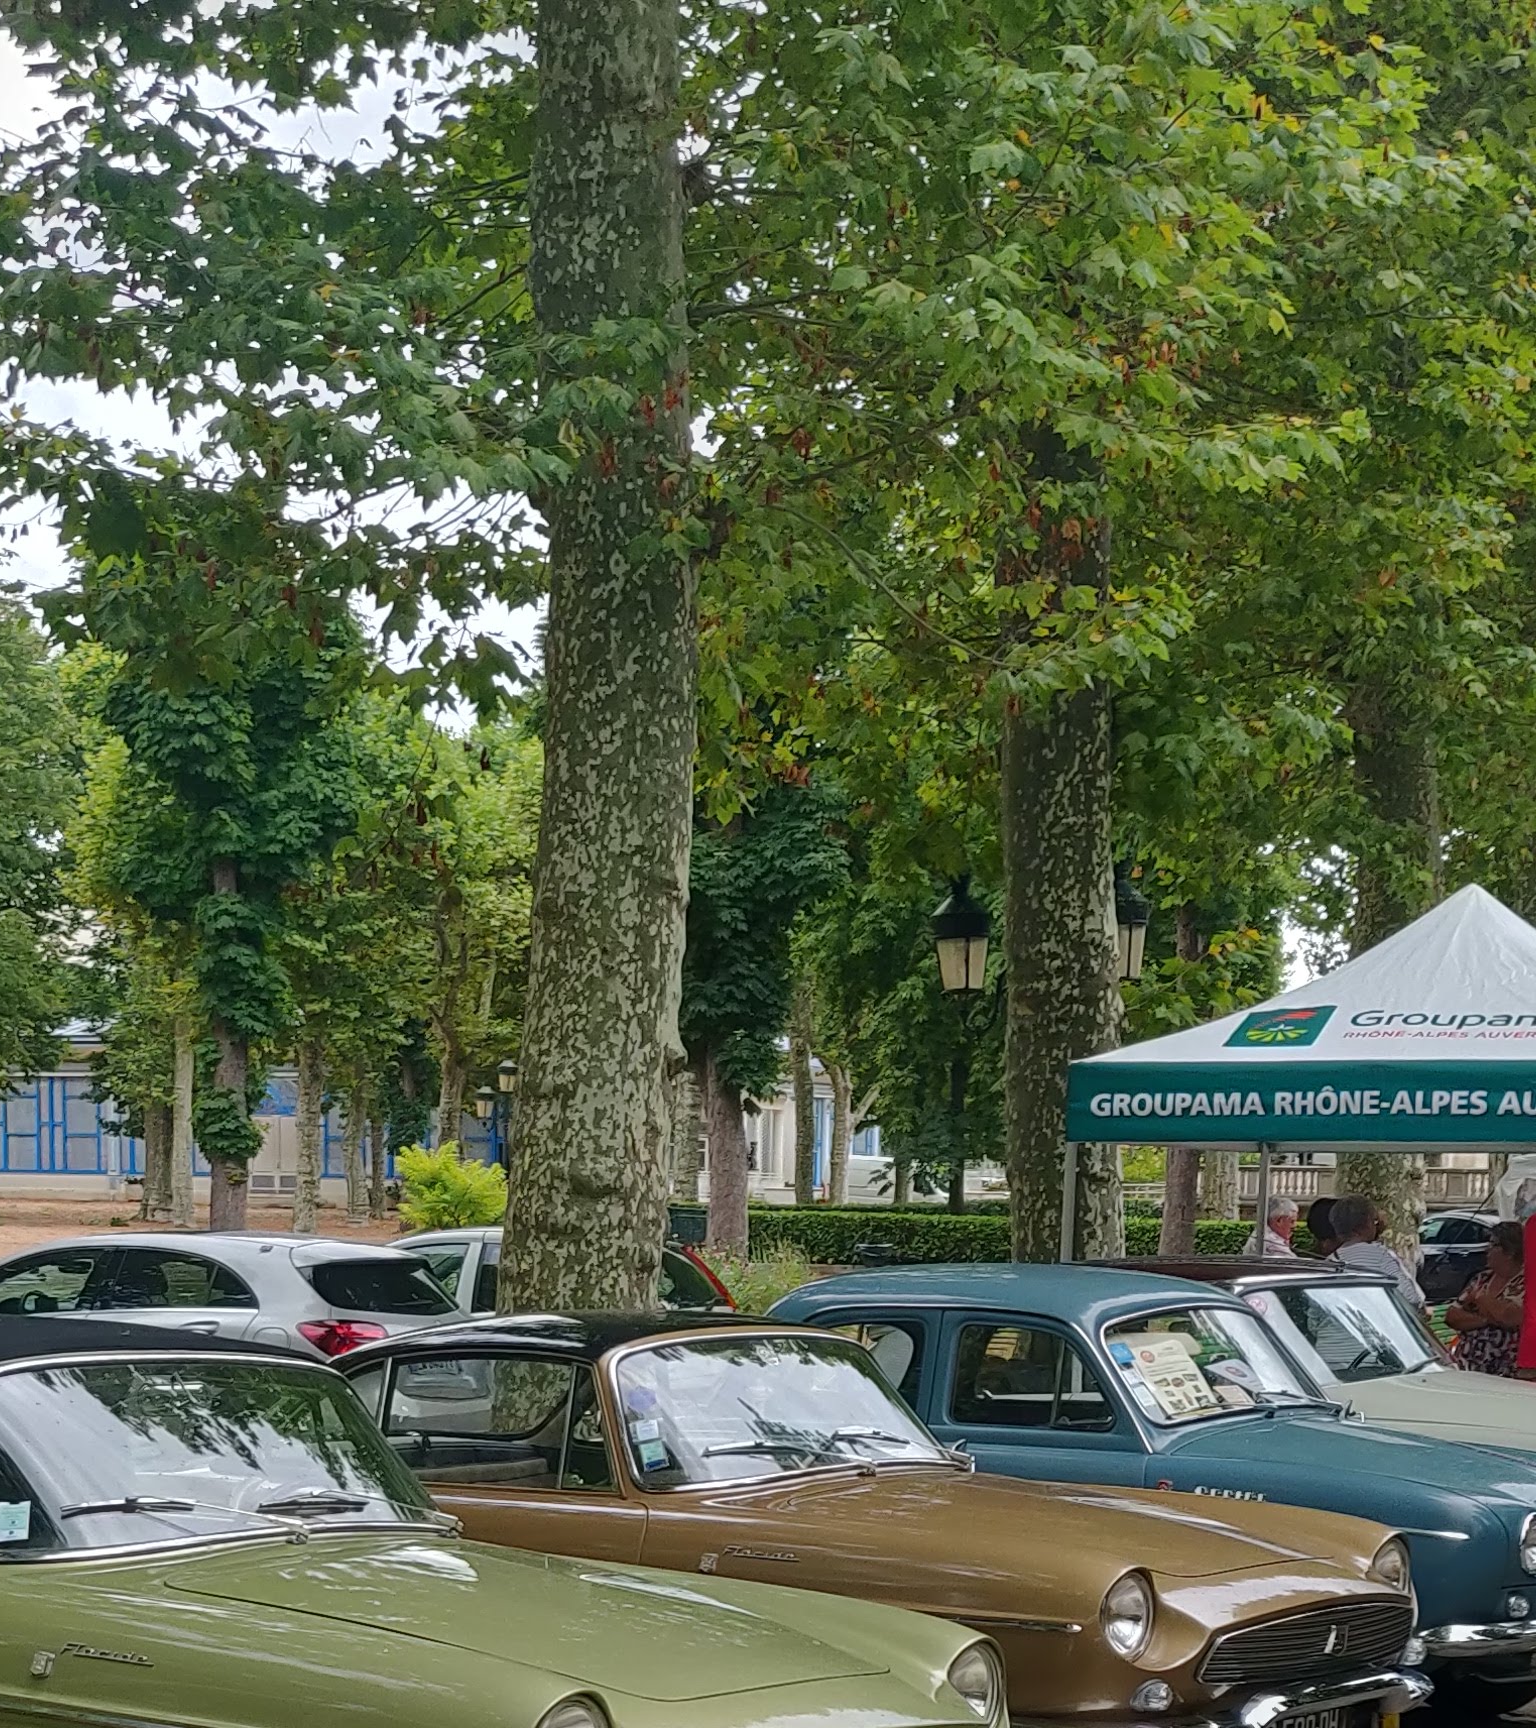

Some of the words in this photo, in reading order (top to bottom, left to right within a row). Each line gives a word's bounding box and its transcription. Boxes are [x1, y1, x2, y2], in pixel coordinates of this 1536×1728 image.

[1089, 1091, 1266, 1118] GROUPAMA
[1273, 1084, 1489, 1117] RHÔNE-ALPES
[59, 1641, 154, 1668] Floride
